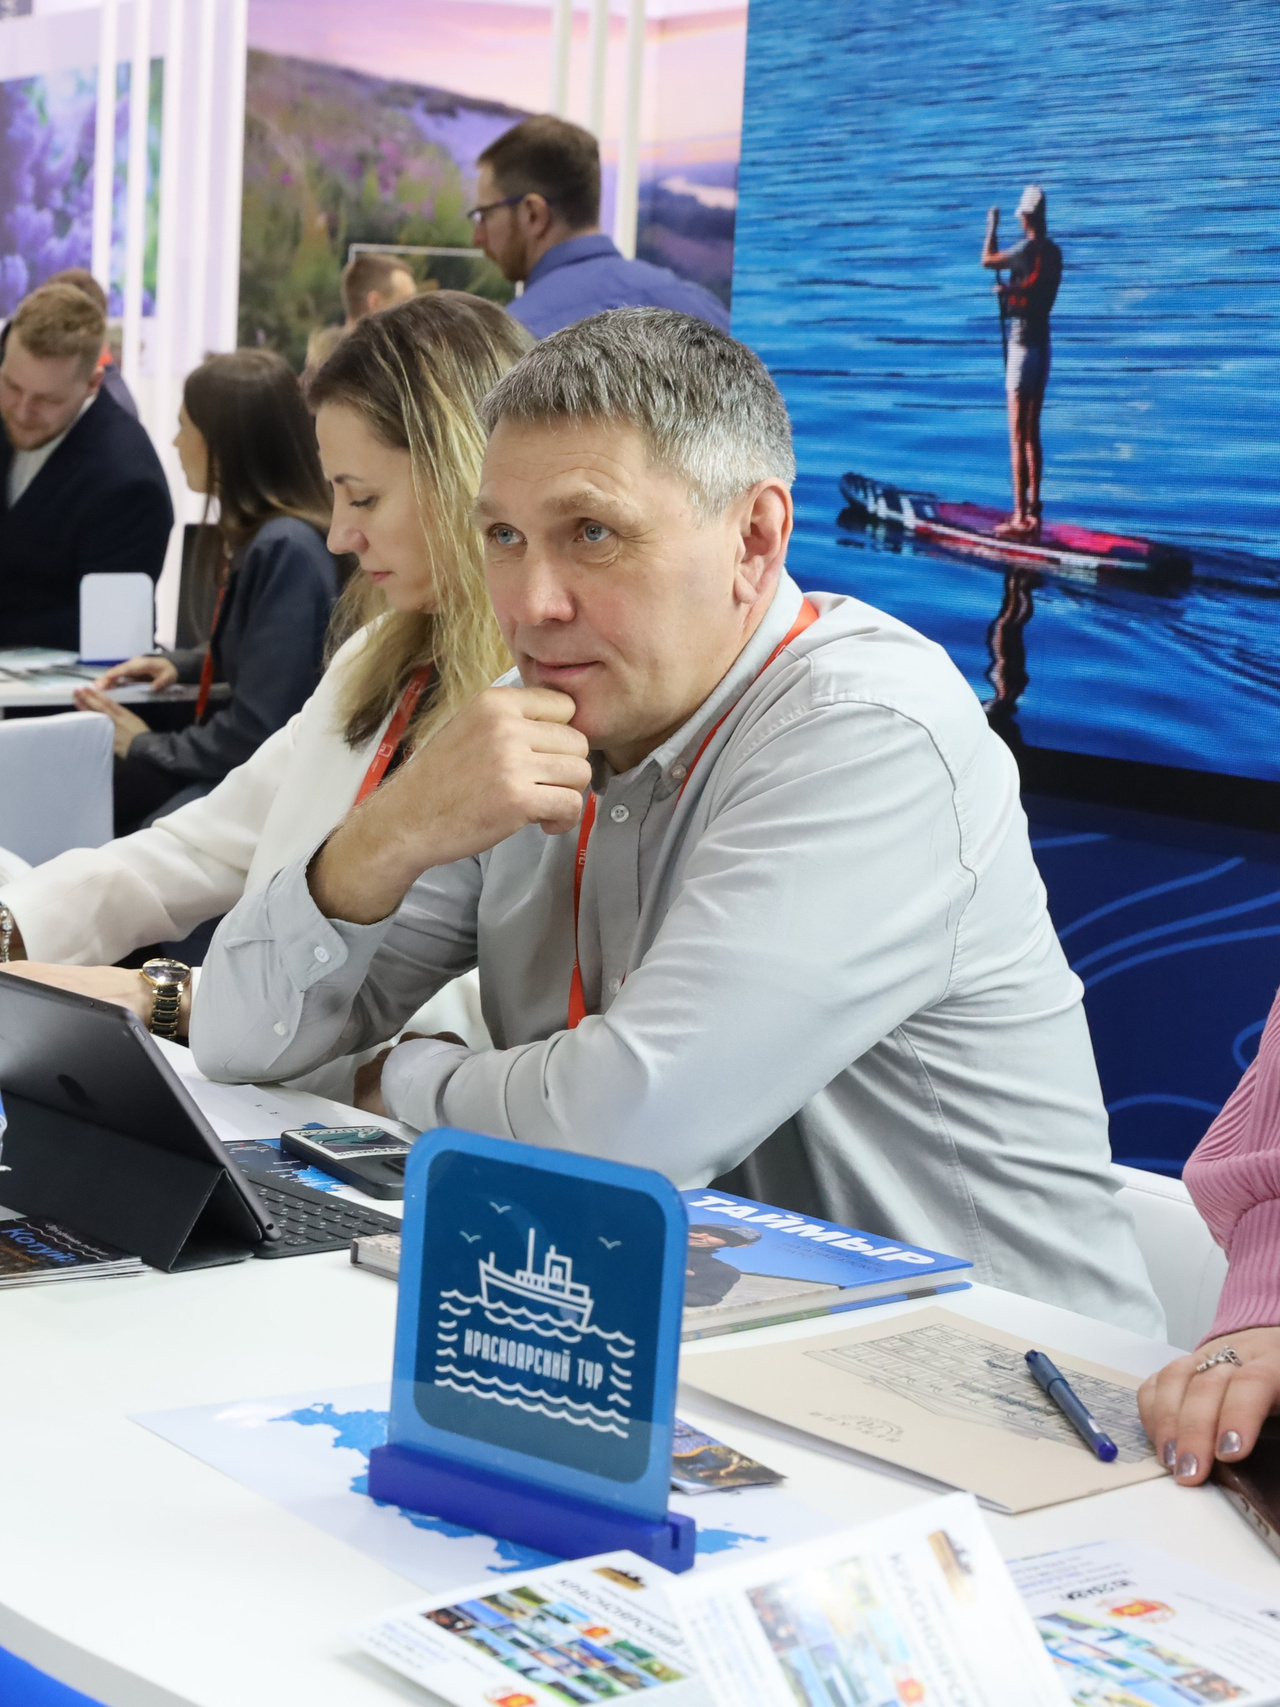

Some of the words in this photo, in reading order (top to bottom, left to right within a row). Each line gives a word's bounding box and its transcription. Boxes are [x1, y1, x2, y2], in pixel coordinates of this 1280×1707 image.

[688, 1194, 936, 1266] ТАЙМЫР
[463, 1328, 572, 1382] КРАСНОЯРСКИЙ
[576, 1357, 605, 1391] ТУР
